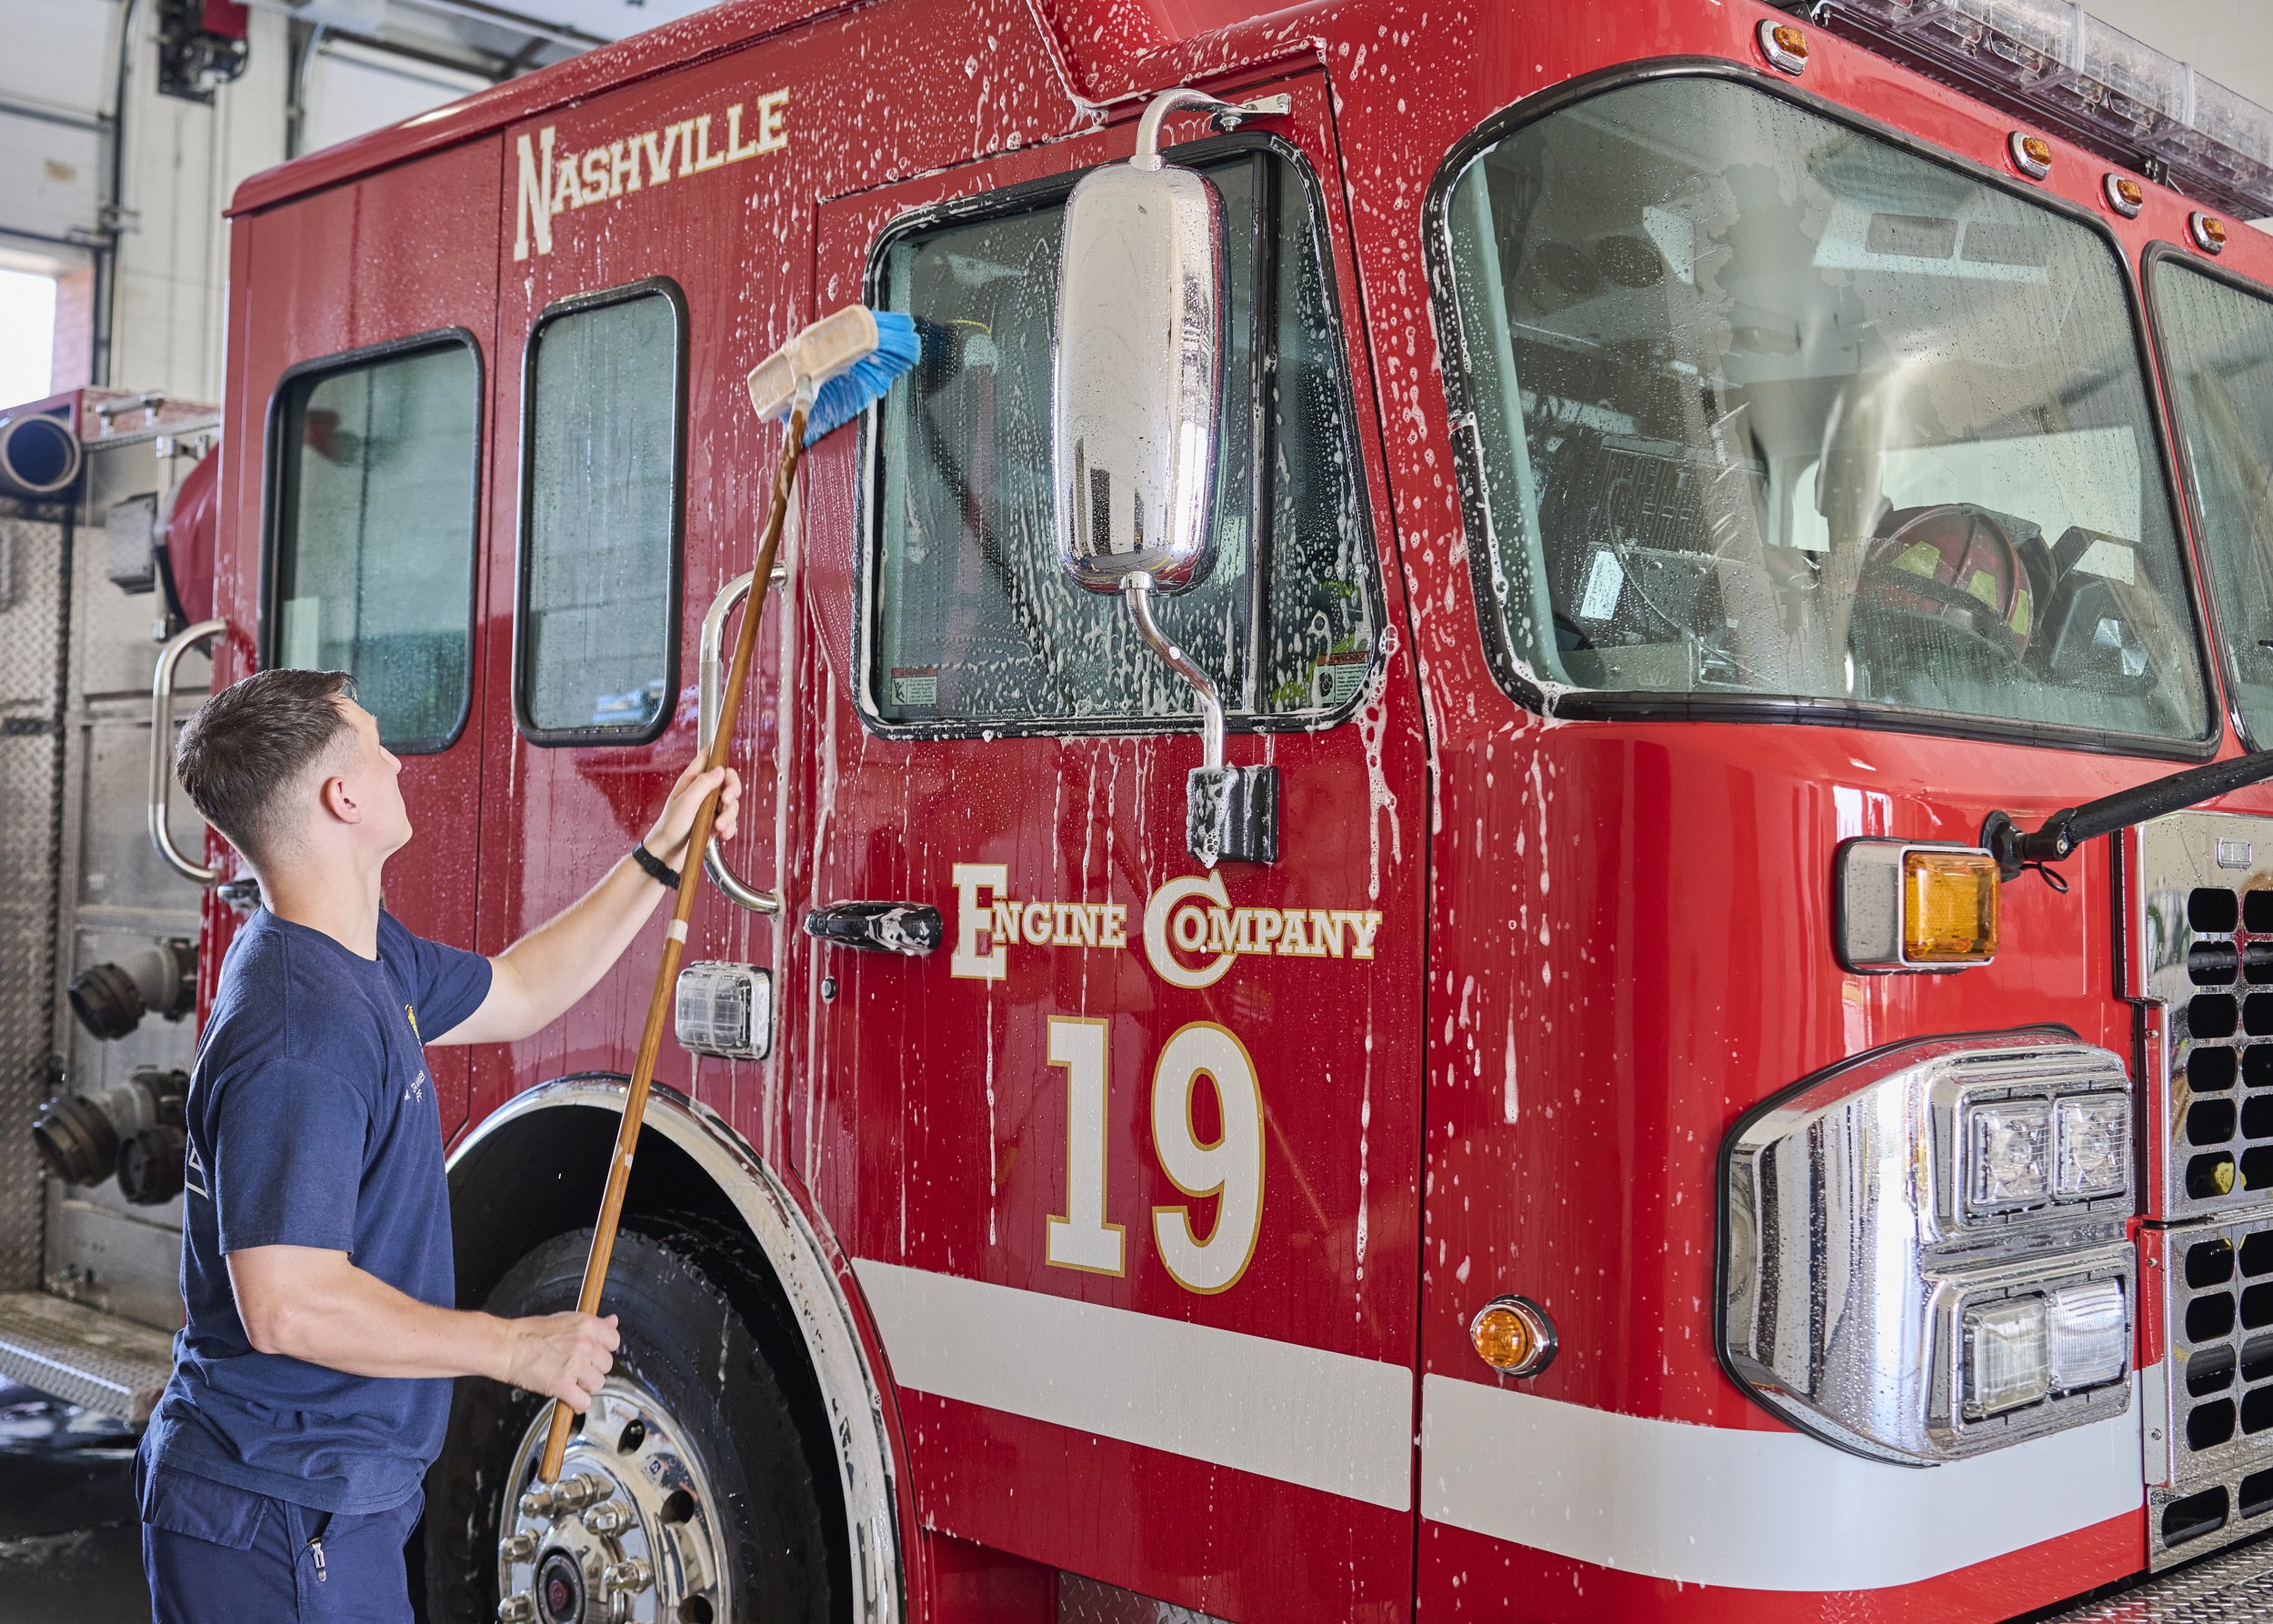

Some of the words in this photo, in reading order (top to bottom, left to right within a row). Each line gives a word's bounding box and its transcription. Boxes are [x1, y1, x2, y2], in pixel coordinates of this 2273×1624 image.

[513, 86, 789, 262] NASHVILLE
[950, 863, 1127, 981] ENGINE
[1144, 869, 1383, 988] COMPANY
[1046, 1015, 1266, 1295] 19
